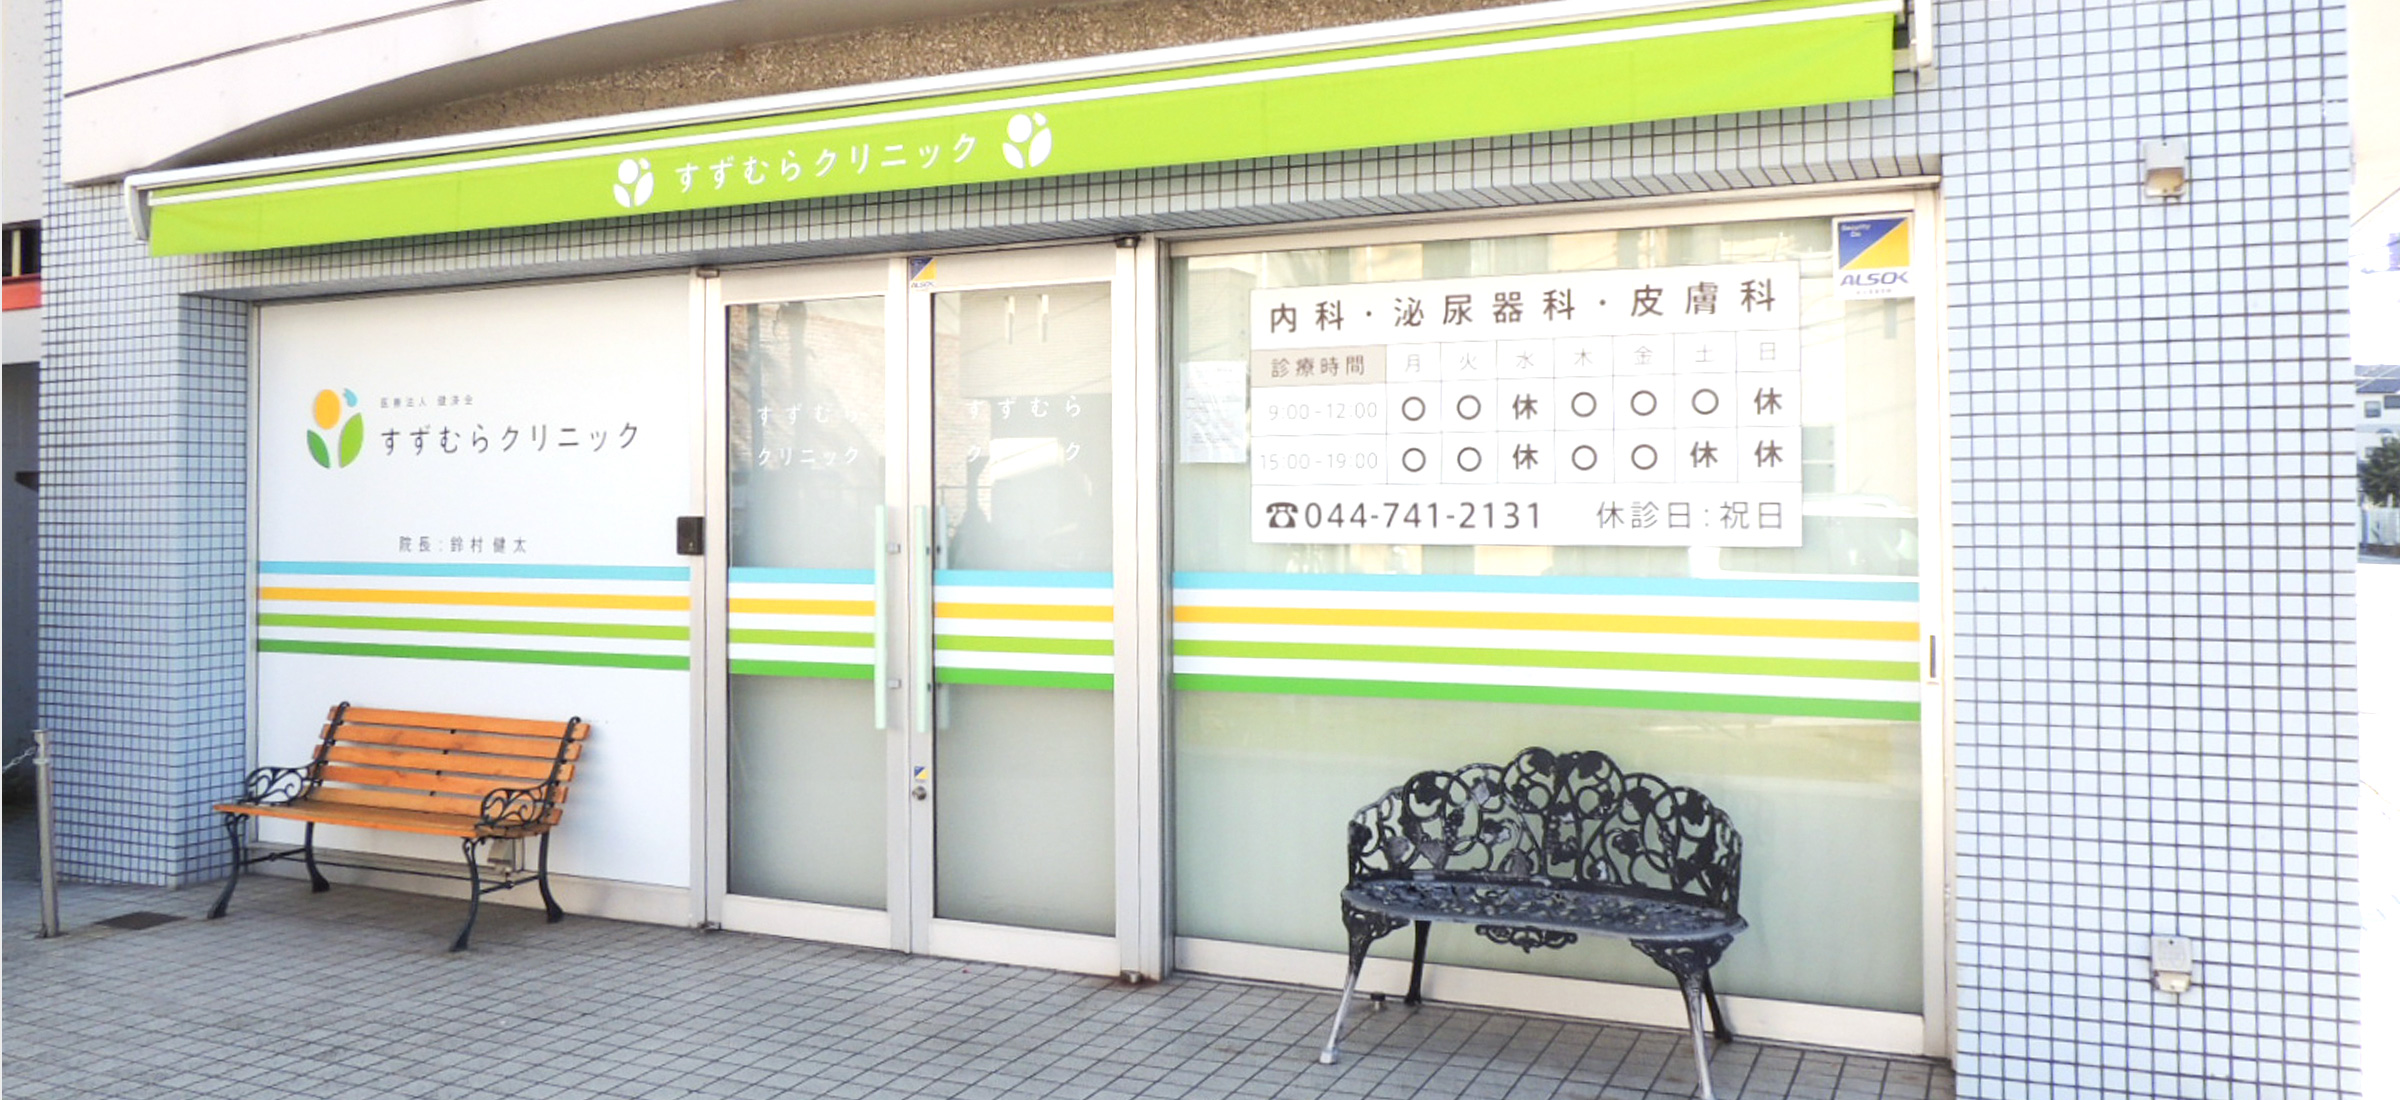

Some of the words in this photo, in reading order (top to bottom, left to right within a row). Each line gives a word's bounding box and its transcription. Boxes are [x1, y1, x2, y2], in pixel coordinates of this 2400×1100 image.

[674, 132, 977, 194] すずむらクリニック
[1840, 271, 1909, 286] ALSOK
[1271, 354, 1365, 378] 診療時間
[1405, 353, 1422, 373] 月
[1459, 352, 1478, 371] 火
[1515, 351, 1534, 369] 水
[1574, 348, 1593, 366] 木
[1633, 345, 1653, 365] 金
[1695, 344, 1714, 362] 土
[1759, 342, 1776, 360] 日
[965, 395, 1081, 420] すずむら
[1512, 393, 1538, 419] 休
[1754, 387, 1782, 415] 休
[381, 422, 638, 456] すずむらクリニック
[759, 446, 858, 466] クリニック
[1512, 443, 1538, 469] 休
[1690, 441, 1718, 468] 休
[1754, 440, 1783, 467] 休
[1304, 502, 1538, 529] 044-741-2131
